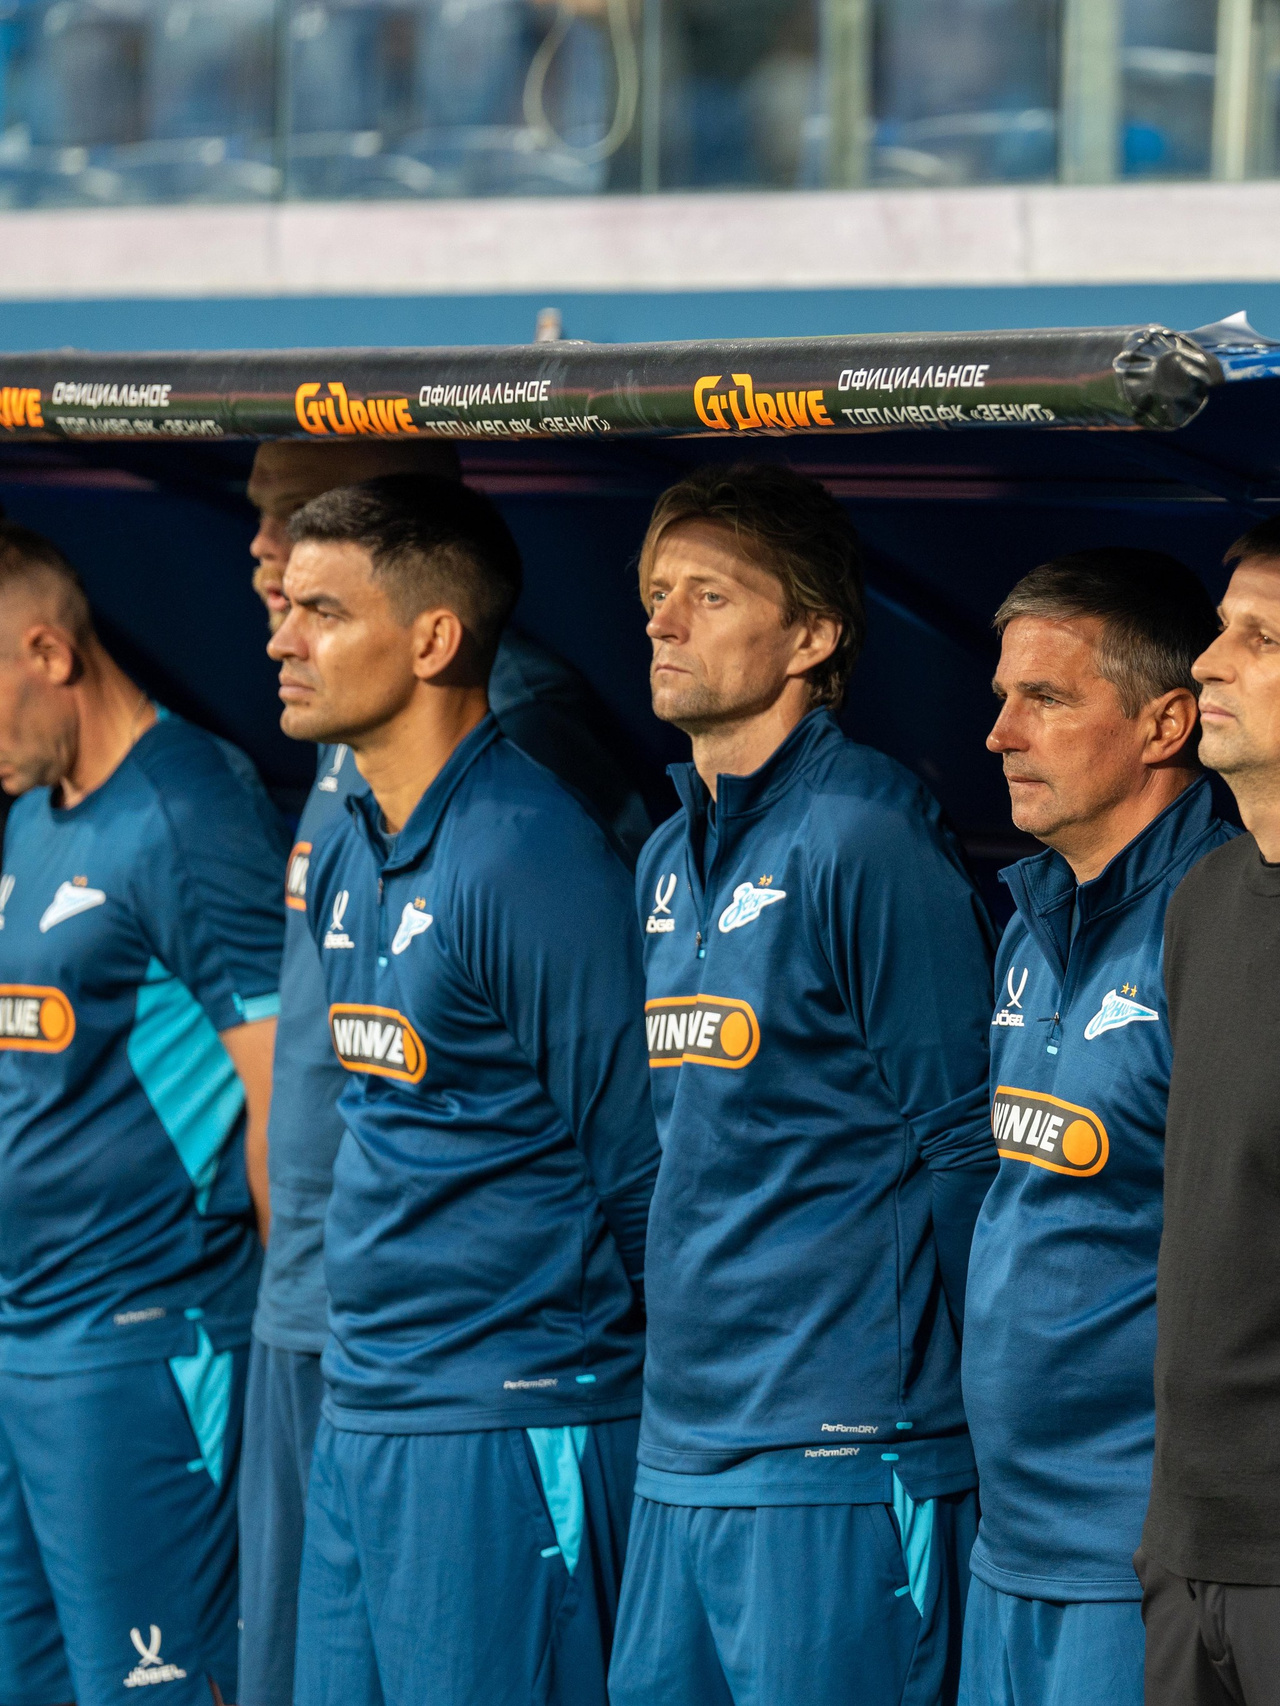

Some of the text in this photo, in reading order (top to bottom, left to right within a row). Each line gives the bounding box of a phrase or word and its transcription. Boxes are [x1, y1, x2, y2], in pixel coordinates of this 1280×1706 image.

[838, 363, 990, 394] ОФИЦИАЛЬНОЕ
[52, 381, 172, 409] ОФИЦИАЛЬНОЕ
[419, 379, 551, 409] ОФИЦИАЛЬНОЕ
[0, 386, 45, 429] IVE
[841, 403, 1056, 425] ТОПЛИВО ФК «ЗЕНИТ»
[56, 416, 133, 436] ТОПЛИВО
[133, 417, 161, 436] ФК
[425, 414, 610, 436] ТОПЛИВО ФК «ЗЕНИТ»
[991, 1009, 1025, 1027] JÖGEL
